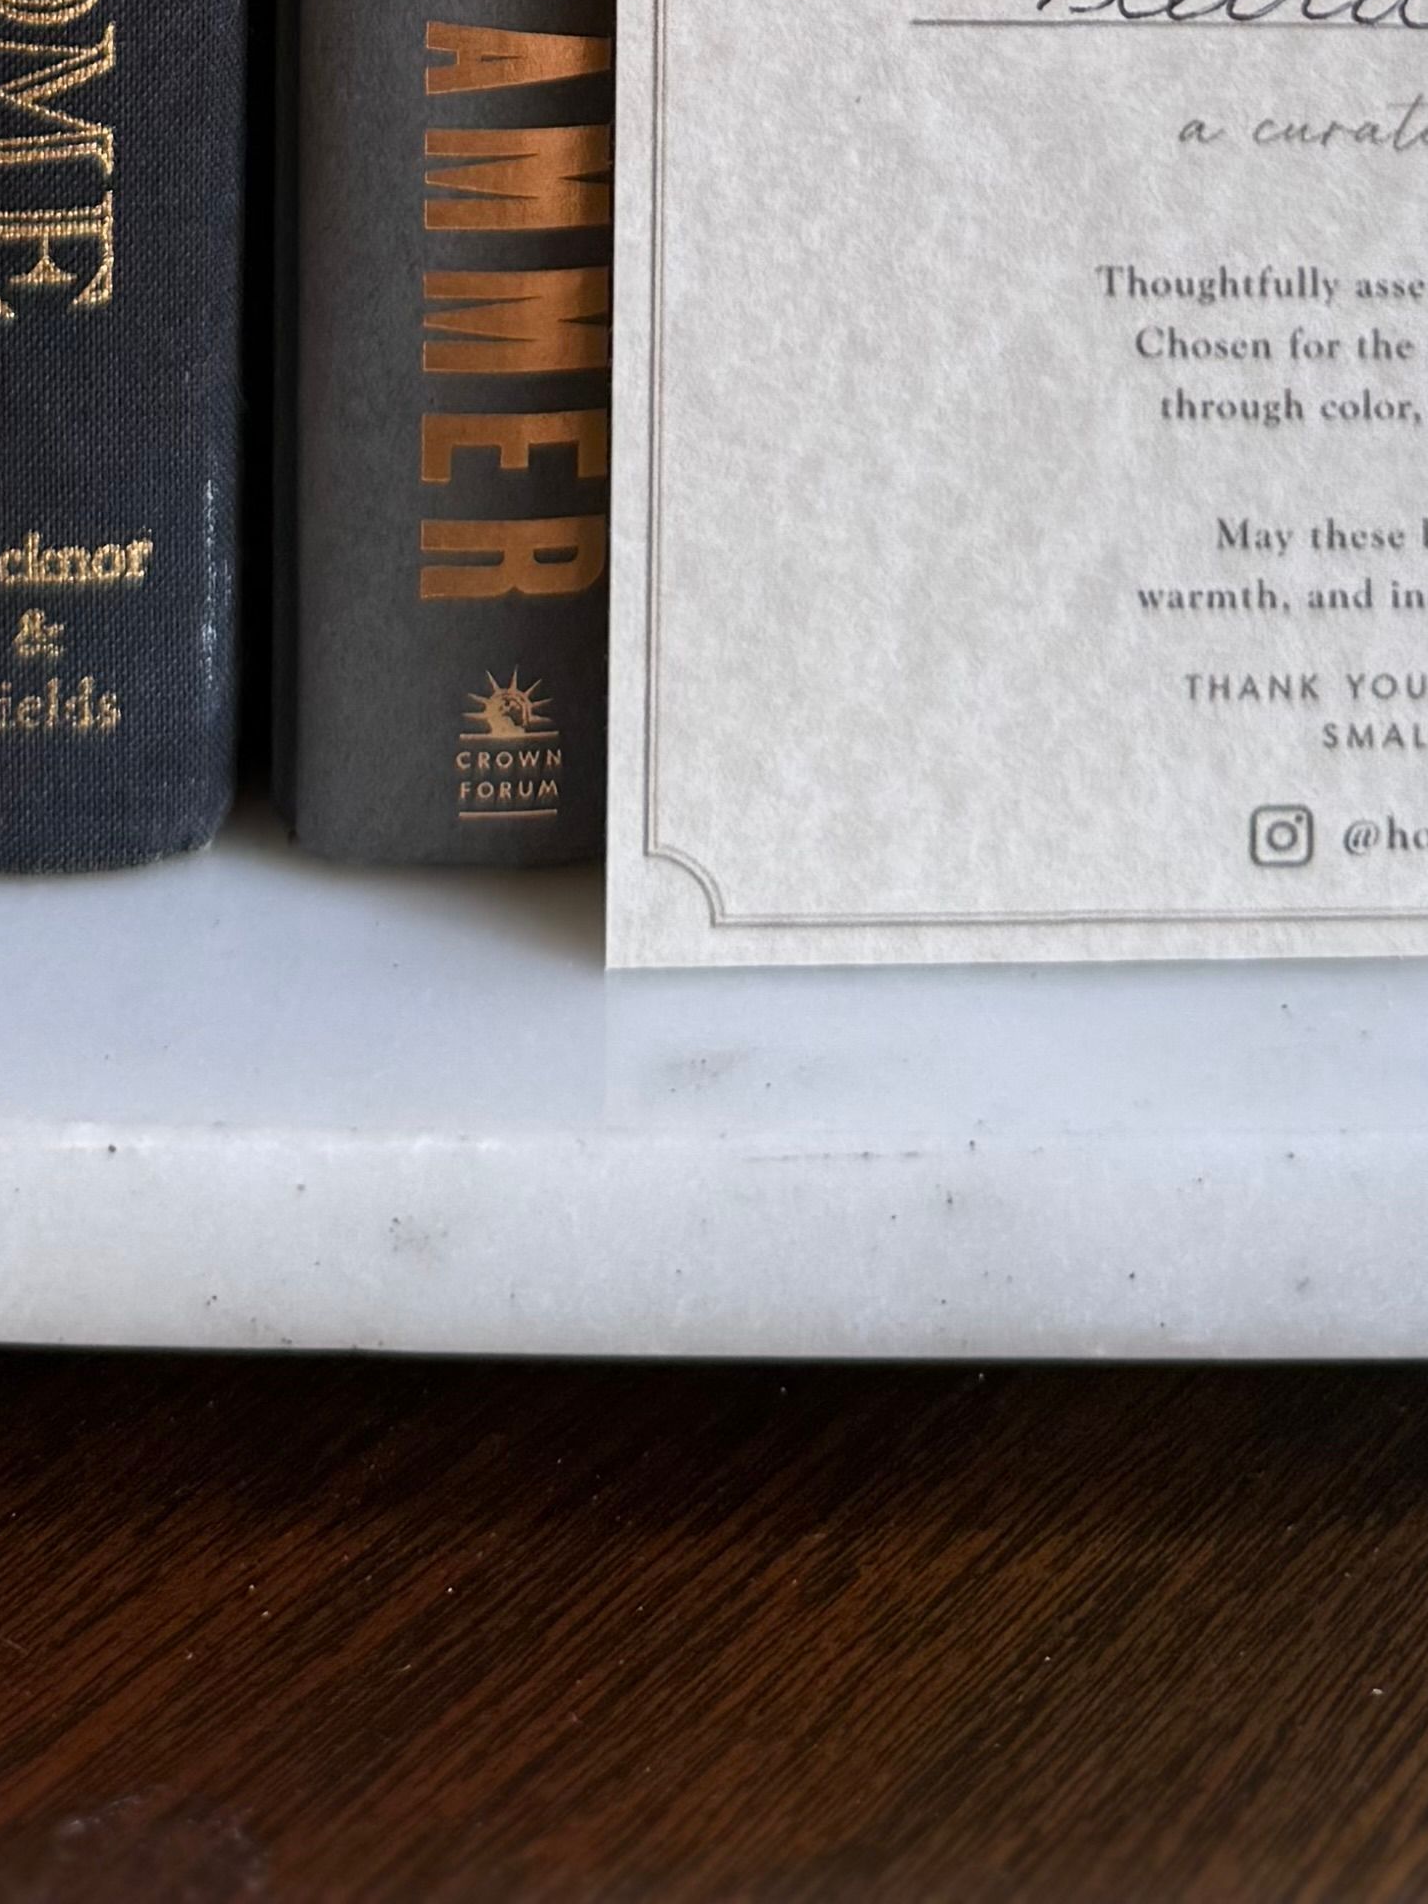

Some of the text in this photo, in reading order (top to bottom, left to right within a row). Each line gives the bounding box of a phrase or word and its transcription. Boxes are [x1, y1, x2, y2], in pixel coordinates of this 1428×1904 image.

[1178, 116, 1223, 147] a
[1095, 265, 1338, 302] Thoughtfully
[1135, 327, 1271, 359] Chosen
[1290, 328, 1340, 360] for
[1358, 329, 1413, 360] the
[1160, 387, 1304, 429] through
[1321, 389, 1421, 425] color,
[1218, 519, 1293, 556] May
[1312, 519, 1404, 550] these
[1138, 579, 1289, 612] warmth,
[1308, 578, 1373, 610] and
[15, 610, 64, 657] &
[1186, 674, 1319, 701] THANK
[1346, 674, 1427, 701] YOU
[456, 750, 563, 771] CROWN
[459, 781, 557, 800] FORUM
